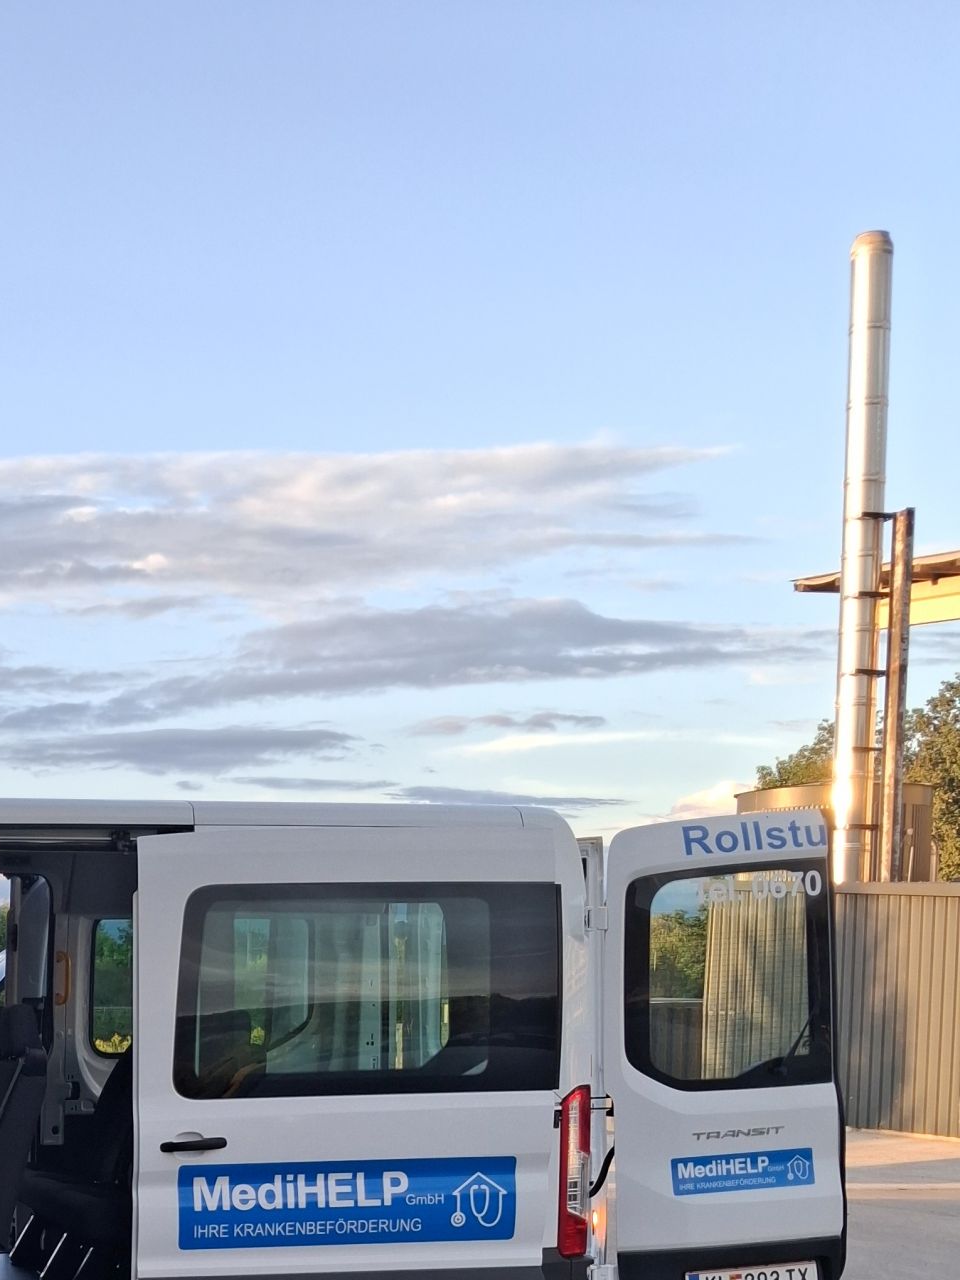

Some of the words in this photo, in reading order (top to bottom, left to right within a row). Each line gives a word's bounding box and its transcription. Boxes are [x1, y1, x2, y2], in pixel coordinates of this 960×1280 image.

[681, 820, 827, 856] Rollstu
[751, 869, 822, 901] 0670
[692, 1126, 785, 1141] TRANSIT
[677, 1156, 769, 1179] MediHELP
[193, 1171, 409, 1212] MediHELP
[405, 1193, 445, 1206] GmbH
[679, 1182, 695, 1190] IHRE
[696, 1176, 776, 1190] KRANKENBEFÖRDERUNG
[194, 1225, 229, 1239] IHRE
[234, 1217, 422, 1238] KRANKENBEFÖRDERUNG
